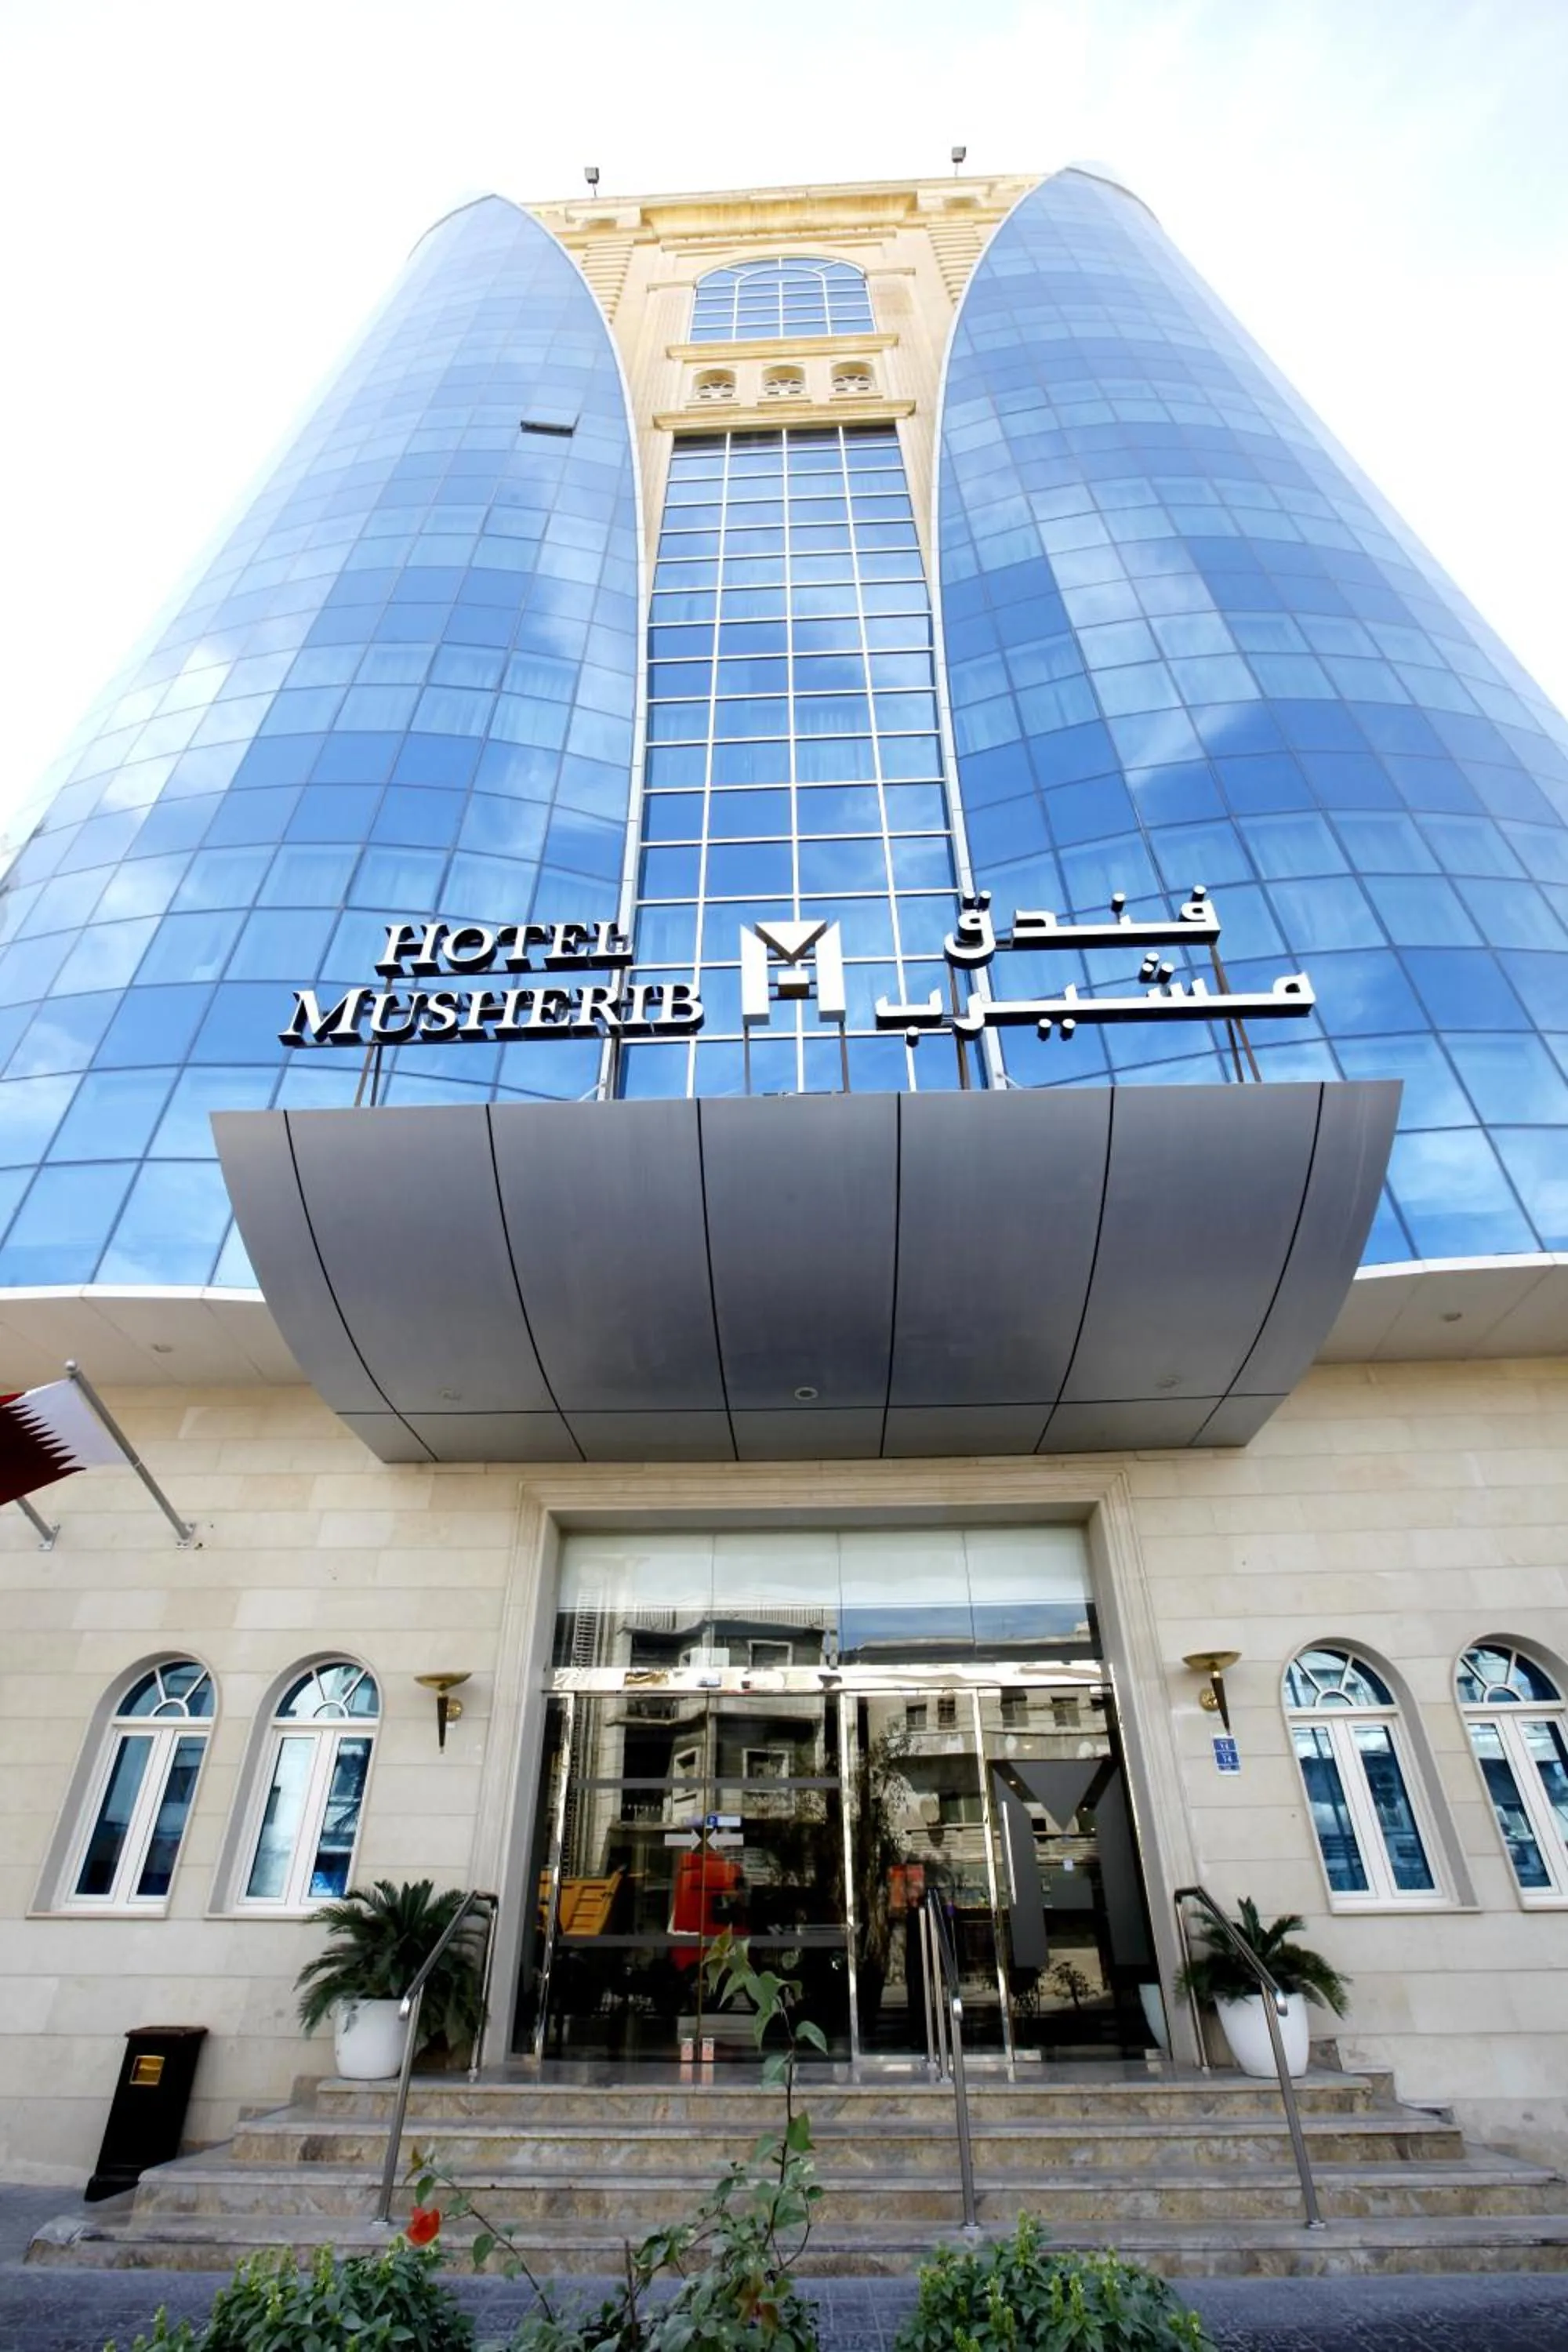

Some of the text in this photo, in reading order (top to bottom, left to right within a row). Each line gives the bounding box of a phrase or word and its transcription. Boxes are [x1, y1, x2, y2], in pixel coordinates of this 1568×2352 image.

[375, 921, 633, 977] HOTEL
[944, 885, 1220, 969] فندق
[278, 983, 705, 1046] MUSHERIB
[876, 952, 1315, 1047] مشيرب
